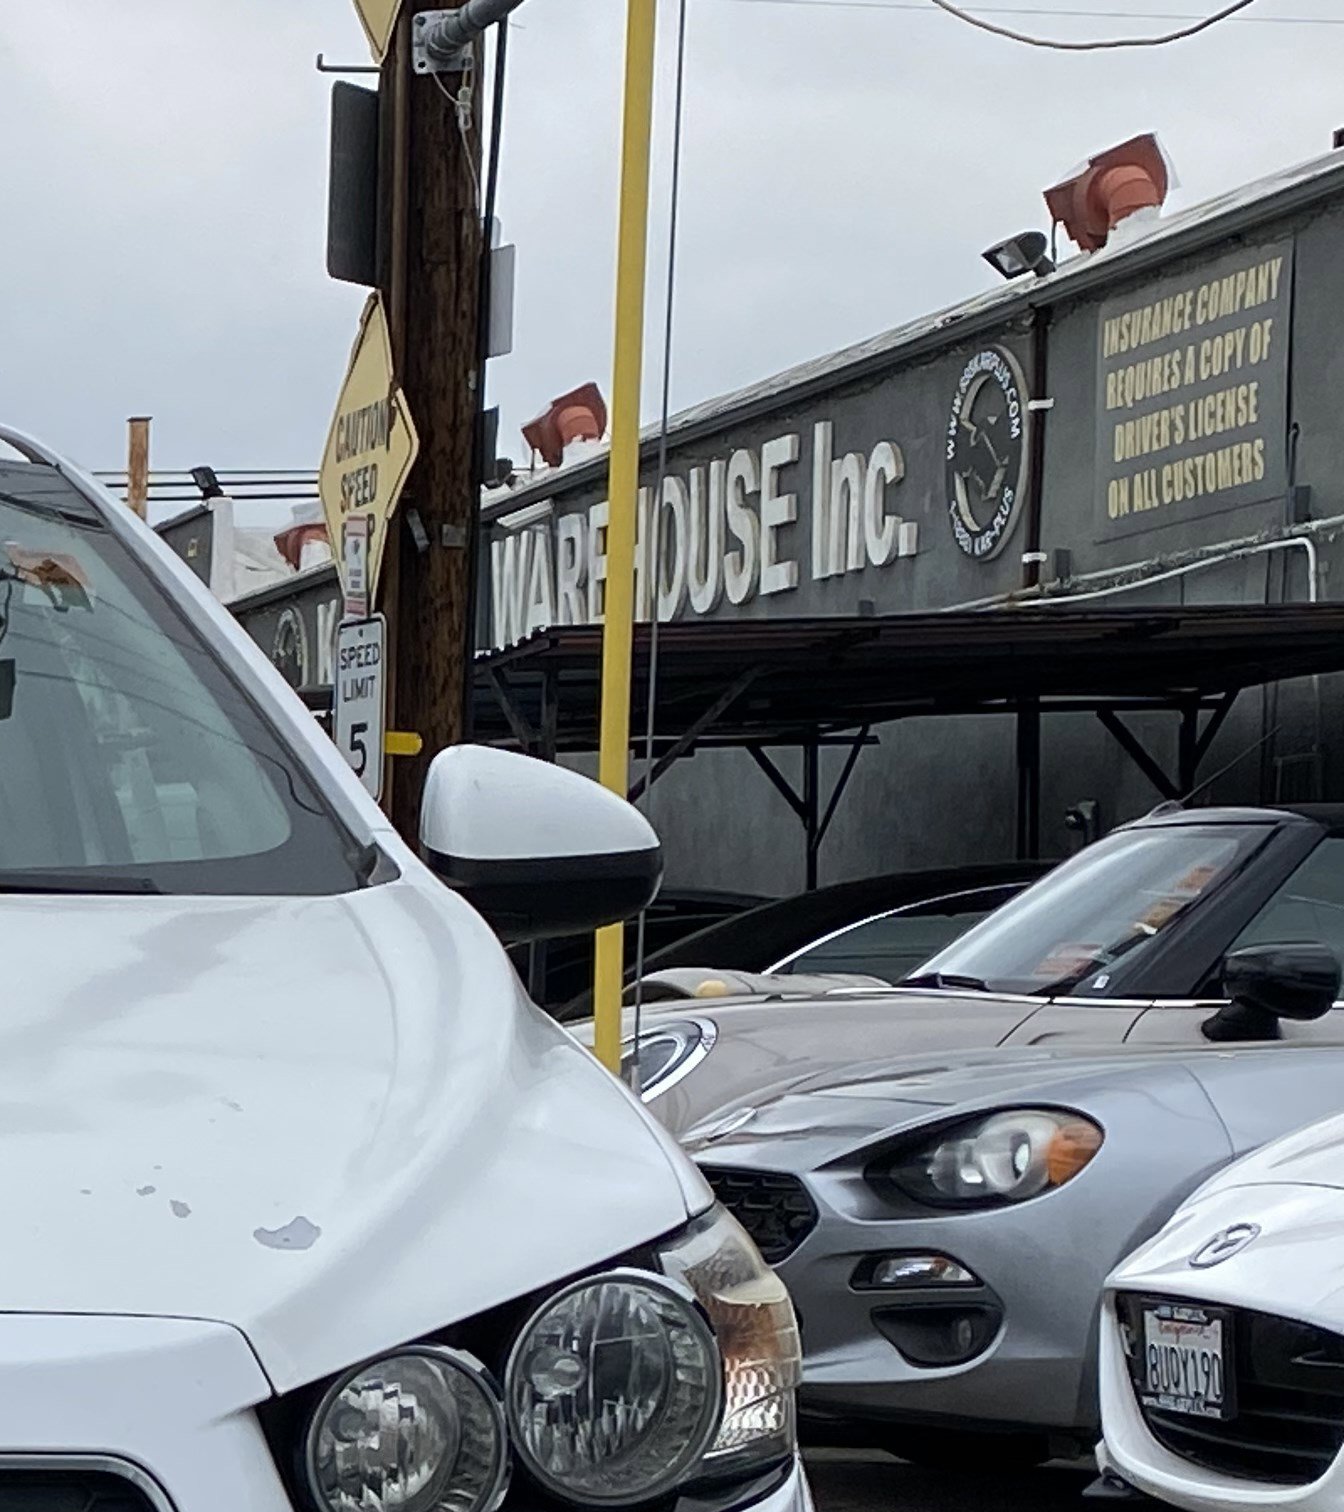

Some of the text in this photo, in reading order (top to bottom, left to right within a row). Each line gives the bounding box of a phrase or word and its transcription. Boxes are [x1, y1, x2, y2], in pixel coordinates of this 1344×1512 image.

[1104, 256, 1282, 358] INSURANCE COMPANY
[1106, 319, 1272, 409] REQUIRES A COPY OF
[336, 398, 390, 464] CAUTION
[1115, 381, 1258, 463] DRIVER'S LICENSE
[340, 463, 378, 513] SPEED
[813, 420, 918, 580] Inc.
[1108, 438, 1264, 519] ON ALL CUSTOMERS
[340, 642, 381, 671] SPEED
[343, 675, 376, 703] LIMIT
[350, 722, 368, 778] 5
